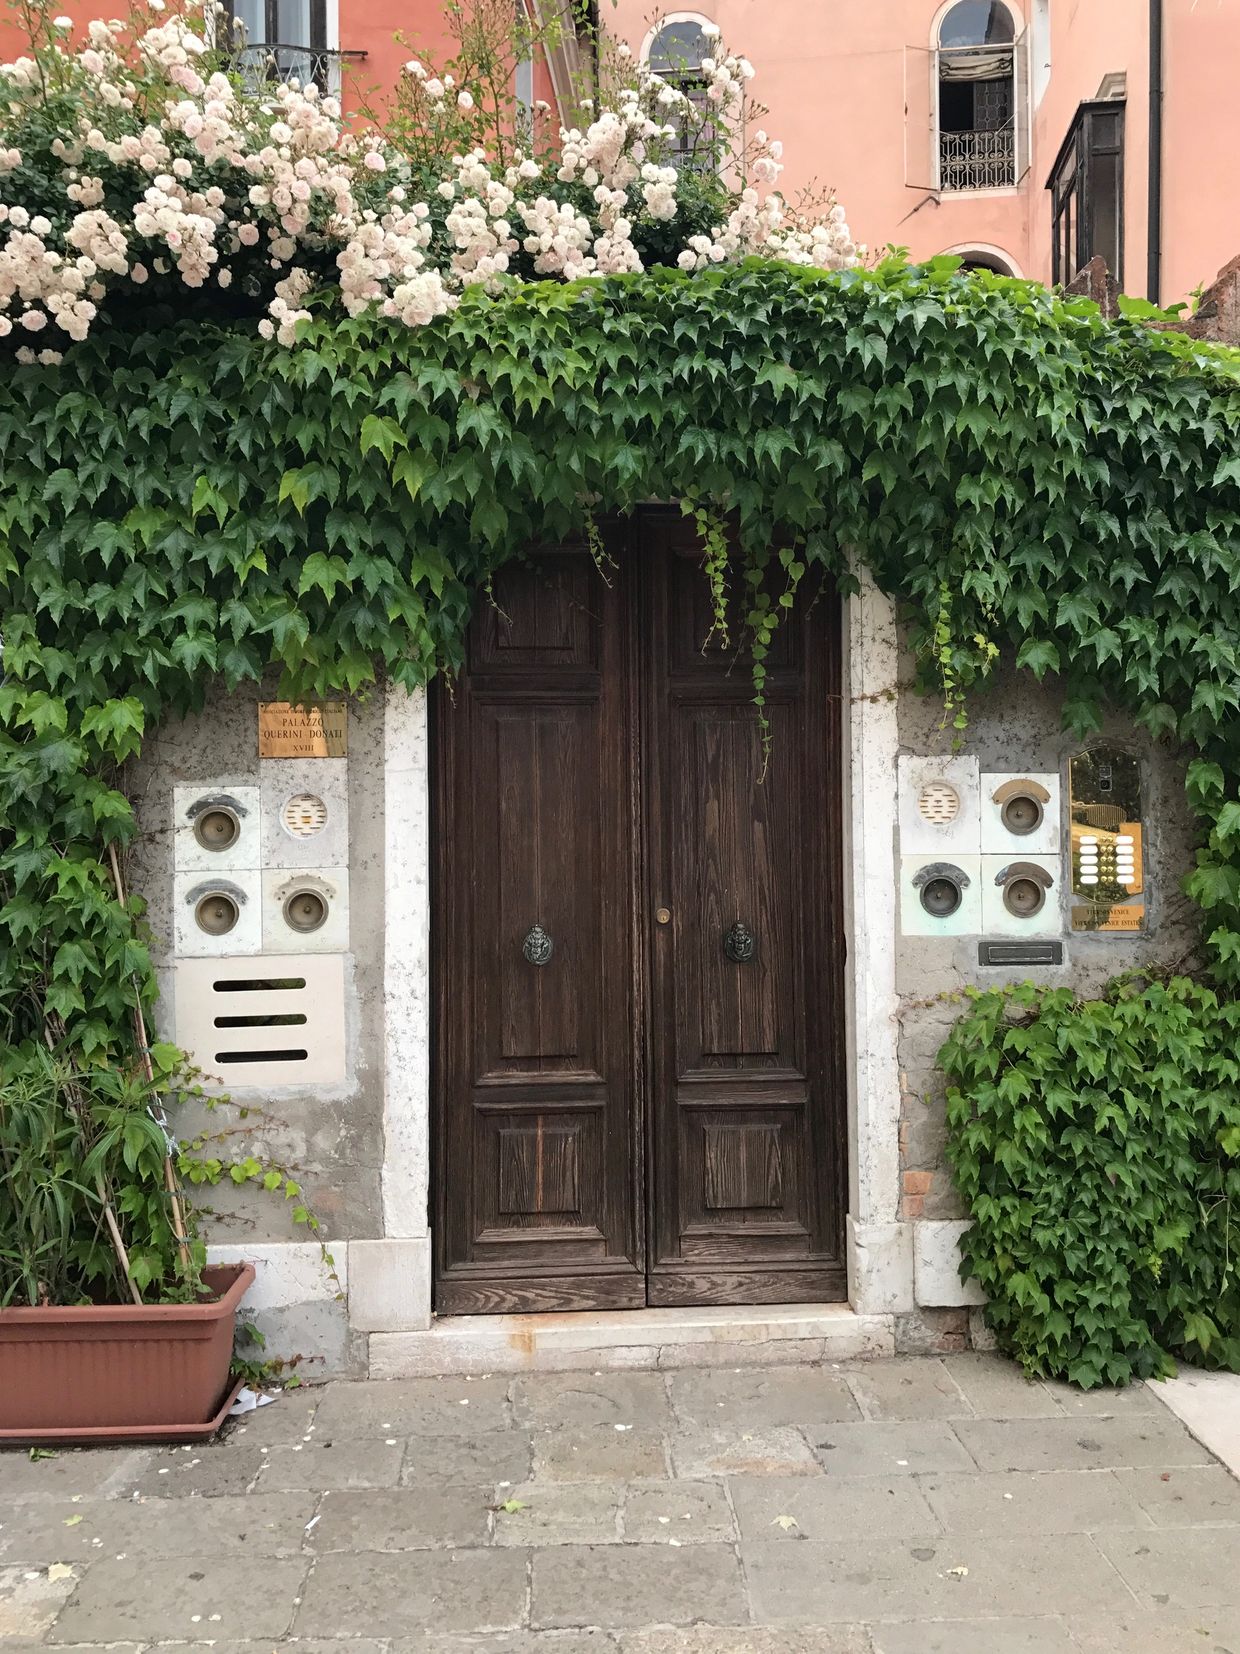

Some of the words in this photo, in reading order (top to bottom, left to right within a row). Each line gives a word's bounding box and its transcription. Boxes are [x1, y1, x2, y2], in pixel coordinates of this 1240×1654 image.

[282, 718, 324, 727] PALAZZO
[263, 730, 302, 740] QUERINI
[309, 729, 342, 739] DONATI
